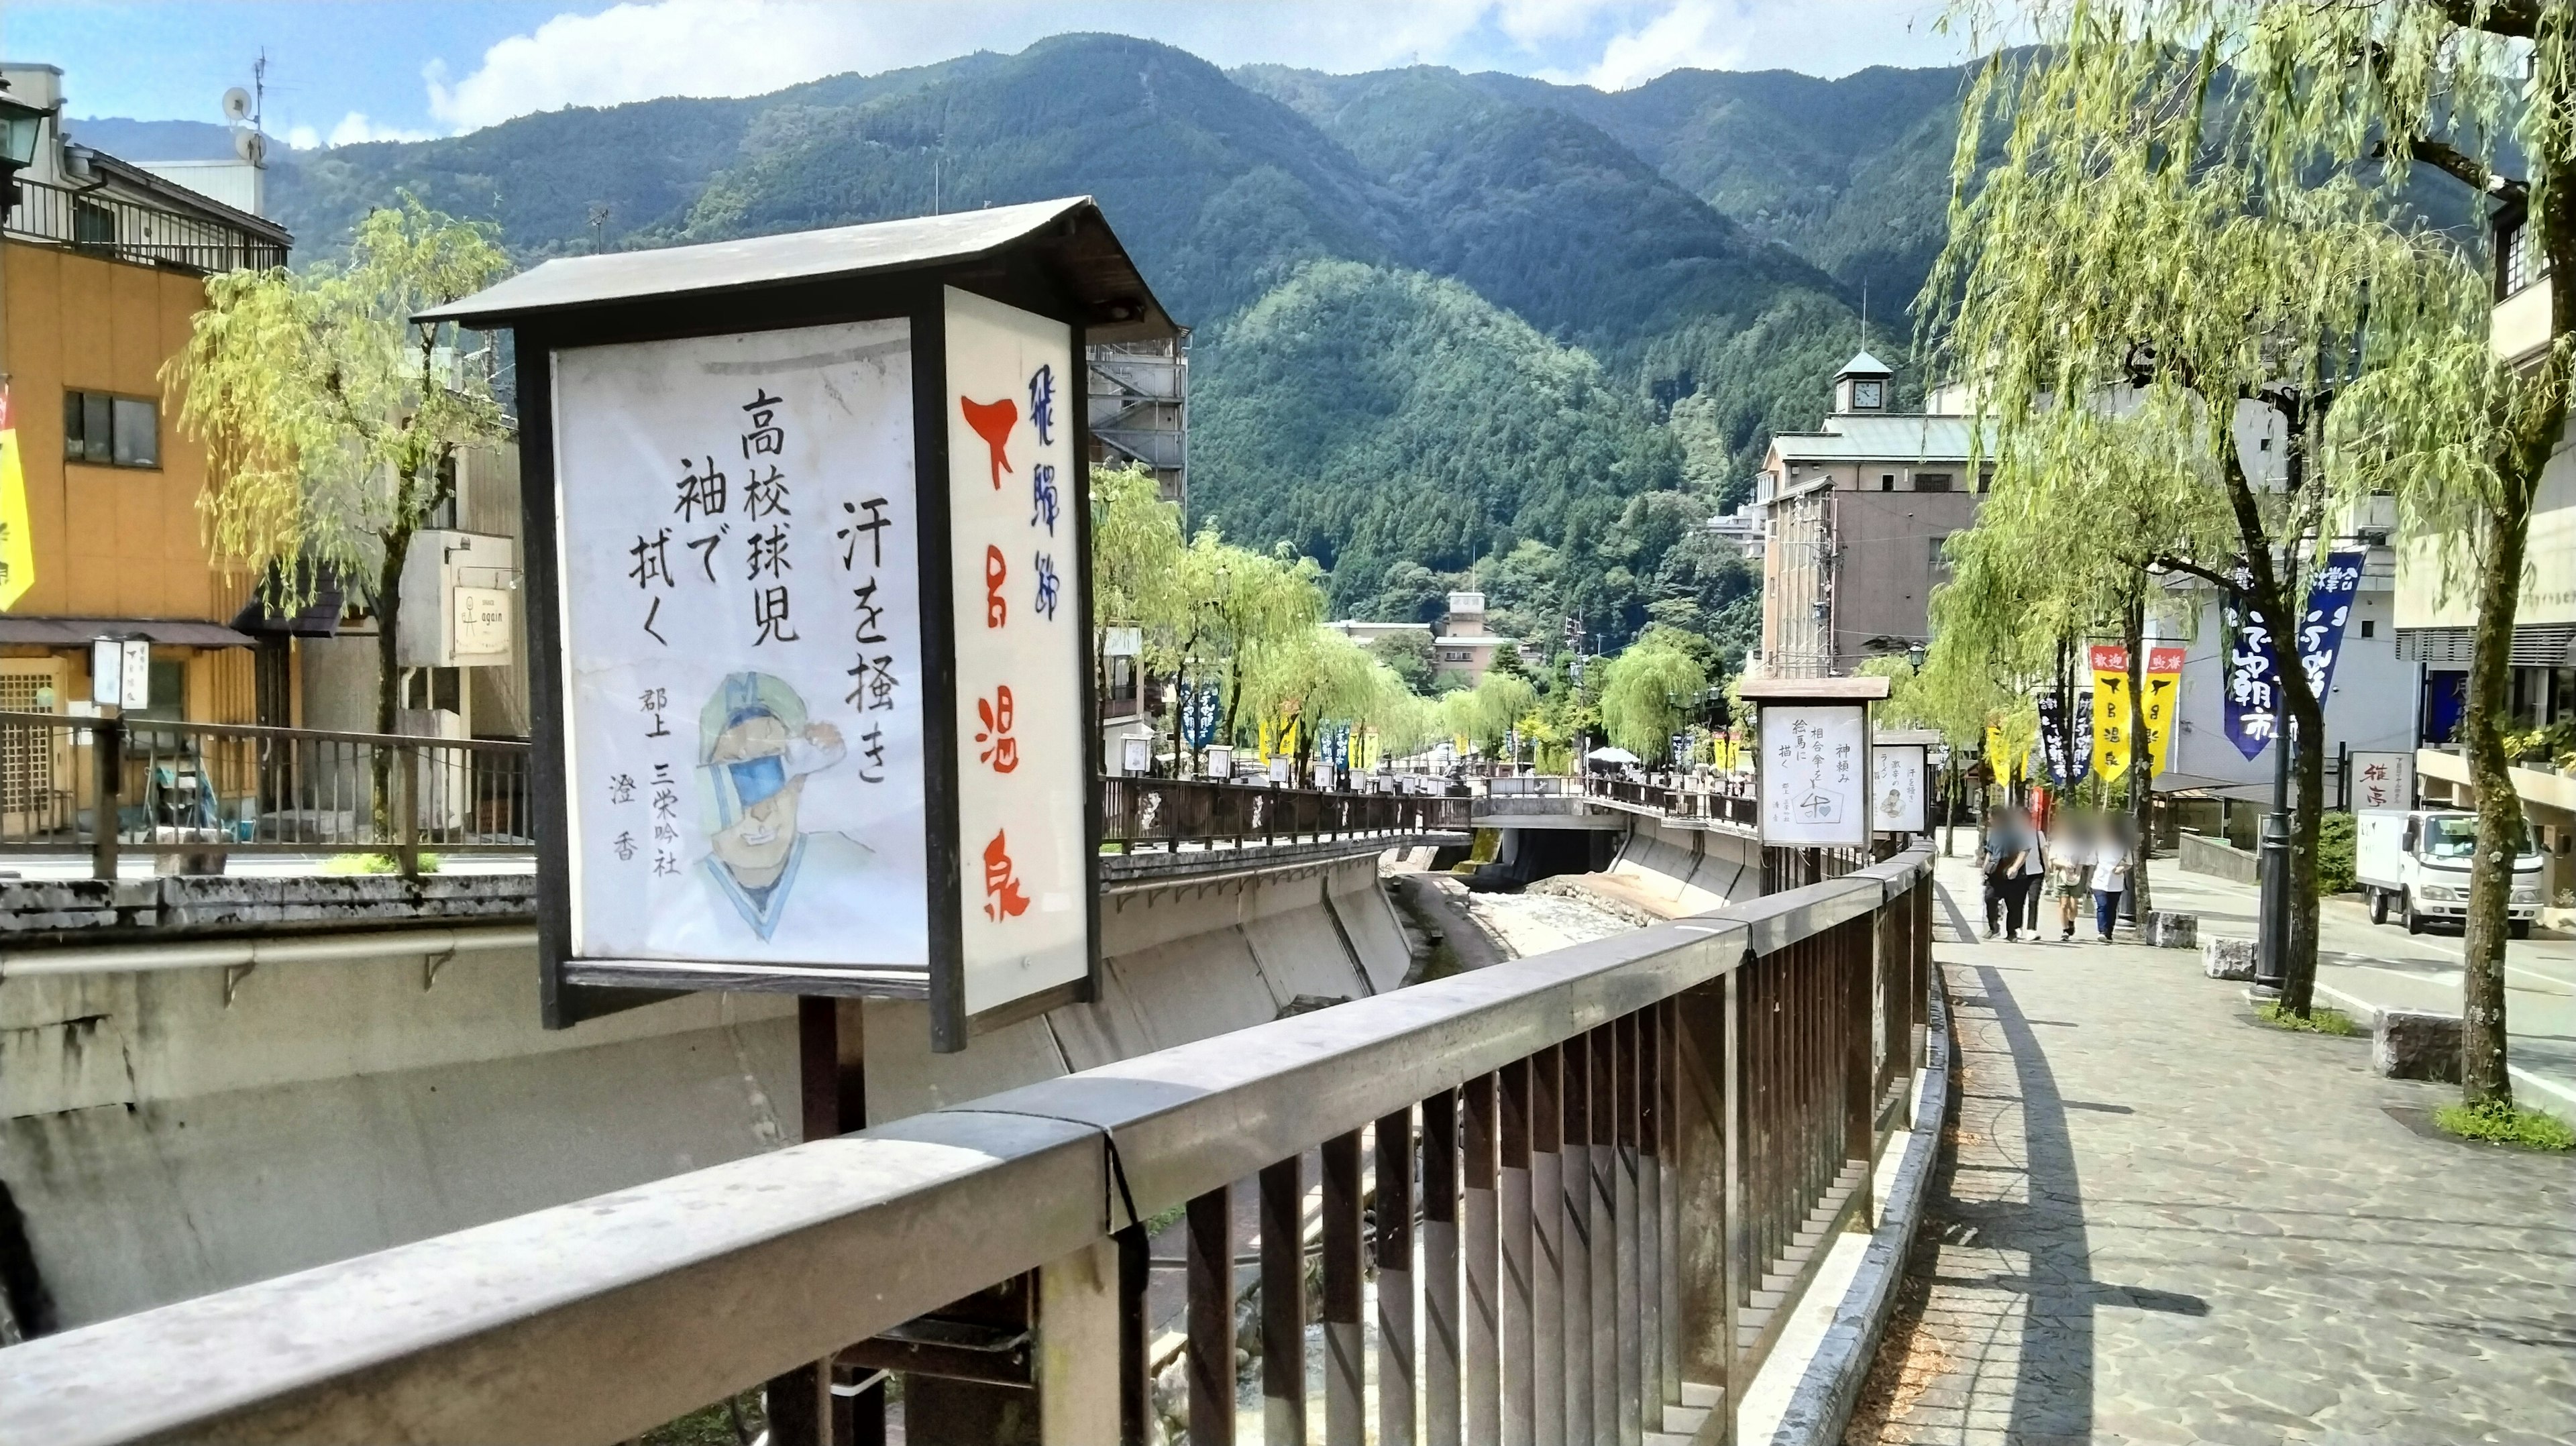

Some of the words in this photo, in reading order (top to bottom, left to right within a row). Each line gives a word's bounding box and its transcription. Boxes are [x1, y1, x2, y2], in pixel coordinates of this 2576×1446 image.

[674, 455, 731, 586] 袖で
[742, 388, 800, 648] 高校球児
[629, 527, 676, 647] 拭く
[482, 612, 502, 626] again
[961, 395, 1030, 923] 下呂温泉
[639, 687, 671, 738] 郡上
[2100, 677, 2121, 766] 下呂温泉
[1778, 744, 1791, 769] 描く
[1792, 719, 1807, 761] 絵馬に
[1811, 726, 1825, 781] 相合傘を
[1835, 744, 1850, 783] 神頼み
[2359, 763, 2390, 808] 雅亭
